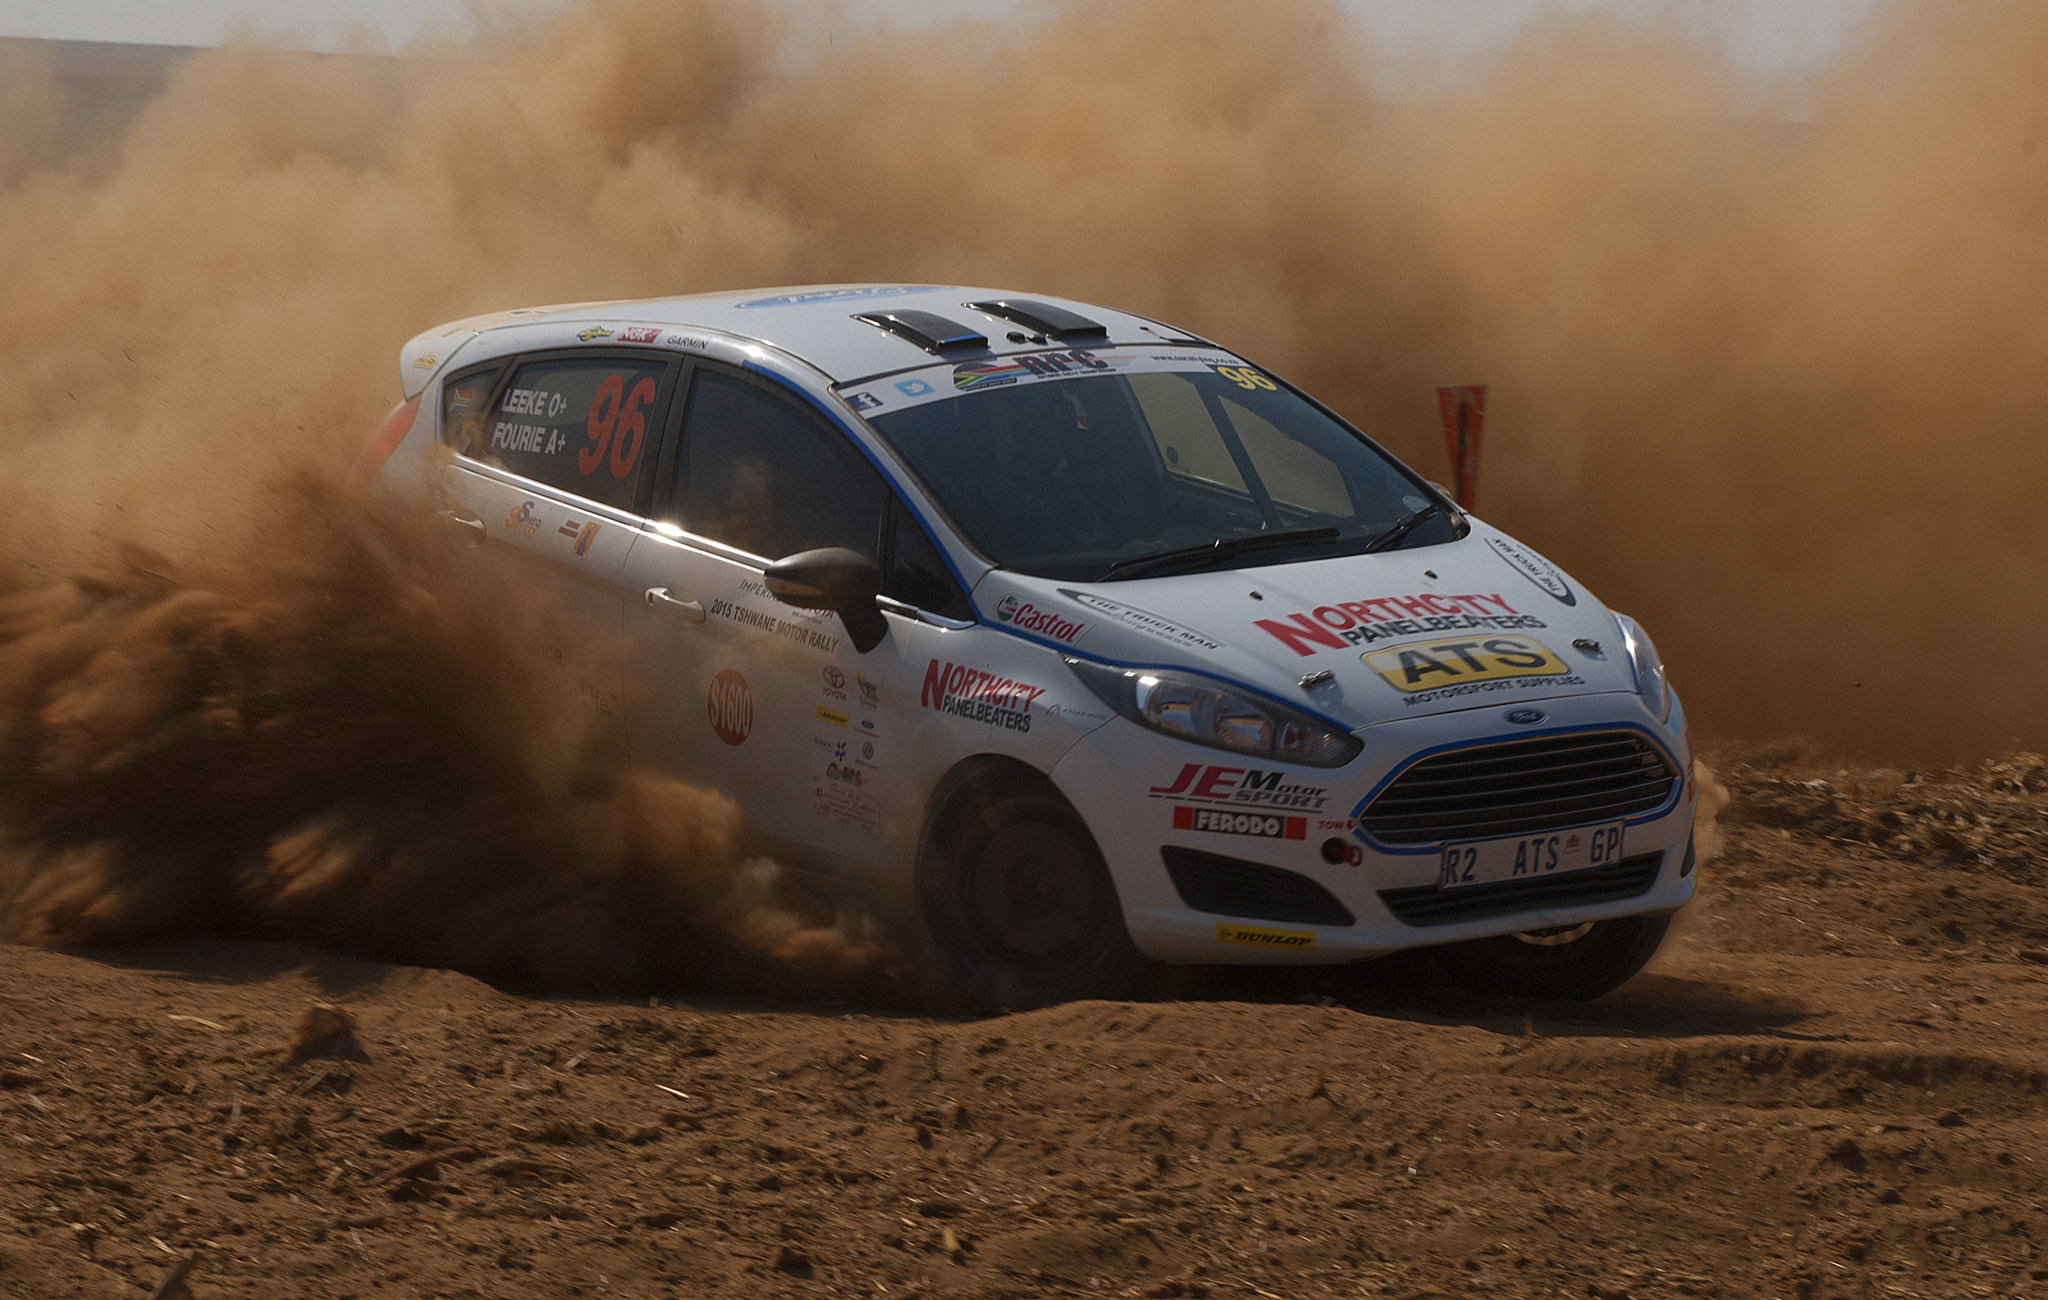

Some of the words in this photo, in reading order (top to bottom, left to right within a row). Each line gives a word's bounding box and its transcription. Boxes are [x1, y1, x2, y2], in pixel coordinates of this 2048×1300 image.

[667, 335, 709, 351] GARMIN
[1216, 366, 1278, 392] 96
[501, 388, 546, 416] LEEKE
[547, 391, 568, 418] O+
[491, 421, 545, 454] FOURIE
[545, 430, 567, 456] A+
[578, 374, 656, 480] 96
[711, 598, 734, 621] 2015
[733, 605, 777, 633] TSHWANE
[775, 619, 810, 643] MOTOR
[807, 631, 840, 654] RALLY
[1013, 603, 1086, 643] Castrol
[1090, 599, 1119, 612] THE
[1124, 610, 1177, 633] TRUCK
[1180, 631, 1218, 650] MAN
[1253, 592, 1520, 657] NORTHCITY
[1341, 612, 1548, 646] PANELBEATERS
[1396, 638, 1548, 685] ATS
[823, 686, 848, 701] TOYOTA
[921, 658, 1048, 713] NORTHCITY
[1402, 680, 1514, 706] MOTORSPORT
[1515, 675, 1586, 688] SUPPLIES
[710, 678, 750, 738] S1600
[942, 694, 1032, 733] PANELBEATERS
[1149, 763, 1245, 800] JE
[1234, 790, 1331, 809] SPORT
[1196, 811, 1282, 836] FERODO
[1318, 819, 1346, 831] TOW
[1445, 847, 1477, 884] R2
[1513, 836, 1560, 876] ATS
[1591, 826, 1620, 864] GP
[1233, 930, 1312, 947] DUNLOP
